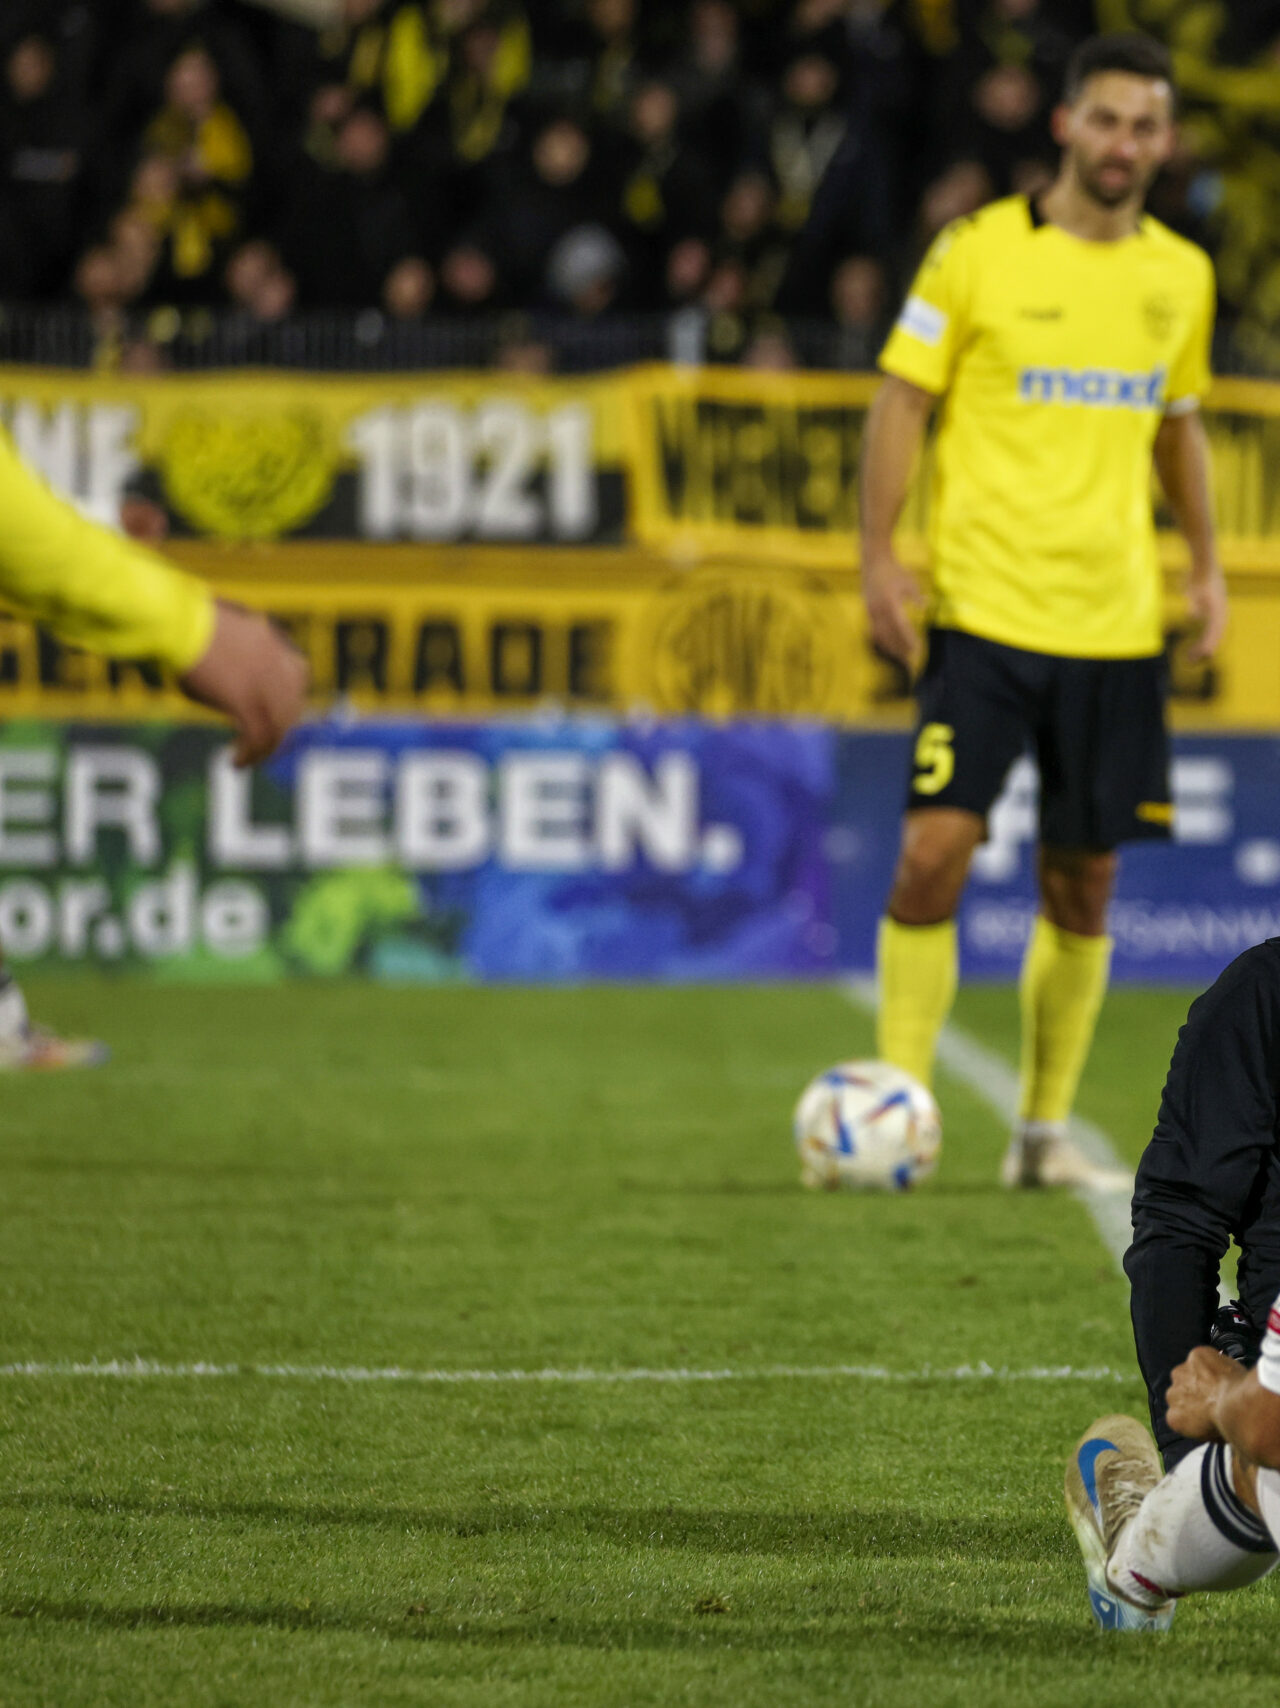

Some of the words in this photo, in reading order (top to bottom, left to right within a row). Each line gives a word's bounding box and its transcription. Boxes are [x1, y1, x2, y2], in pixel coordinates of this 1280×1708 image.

[343, 402, 597, 536] 1921
[208, 749, 744, 870] LEBEN.
[914, 722, 955, 796] 5
